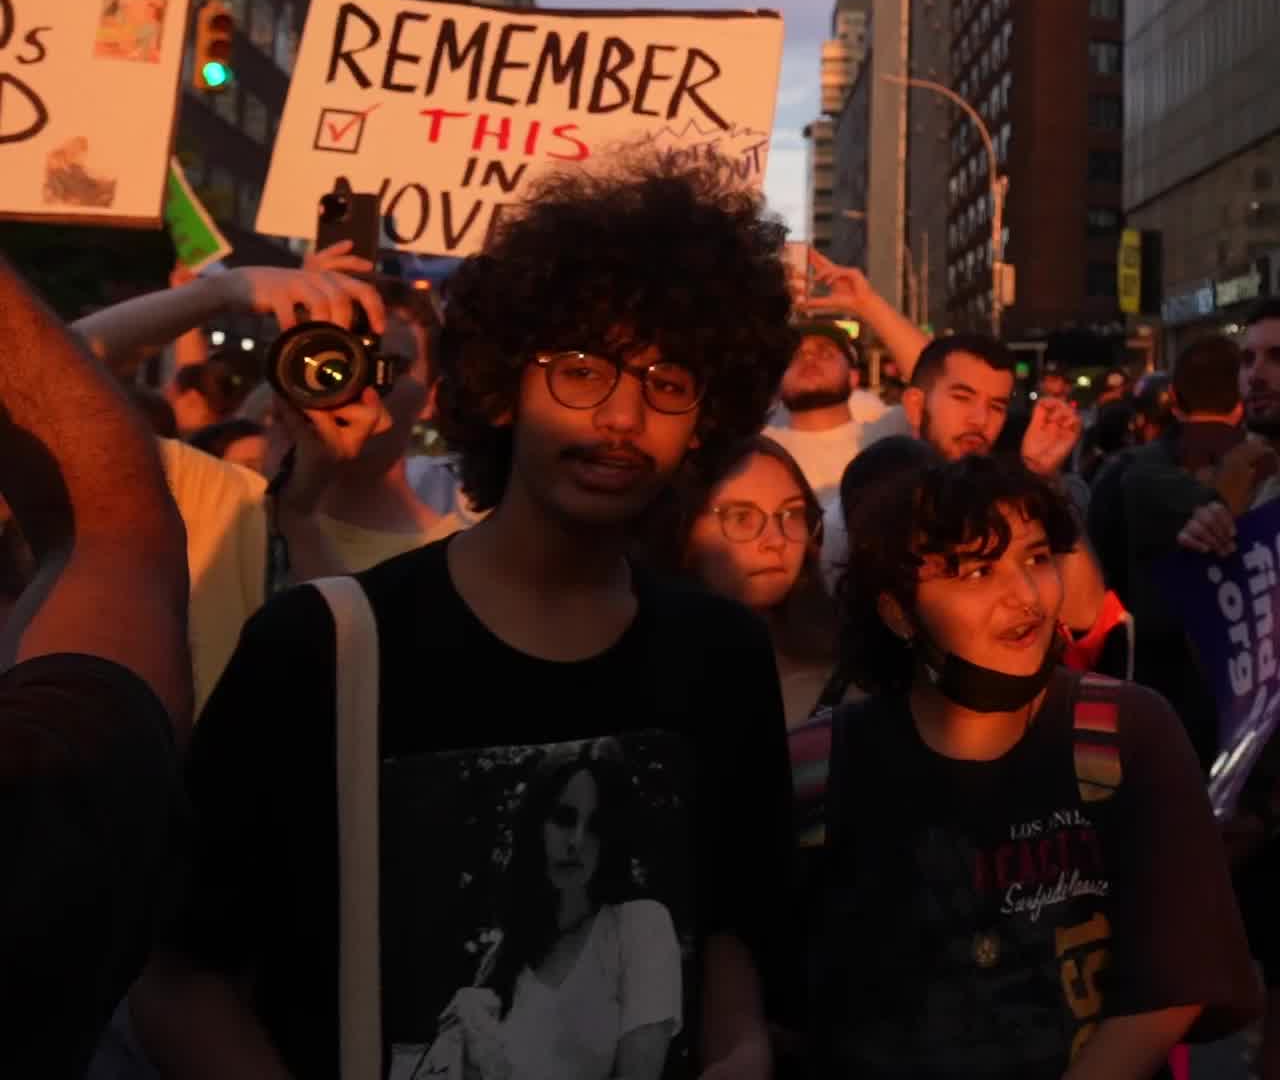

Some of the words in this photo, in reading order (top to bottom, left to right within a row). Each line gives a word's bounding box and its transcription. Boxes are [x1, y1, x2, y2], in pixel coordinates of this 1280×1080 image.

[326, 2, 729, 130] REMEMBER
[419, 109, 591, 161] THIS
[462, 157, 526, 192] IN
[1206, 564, 1254, 698] .org
